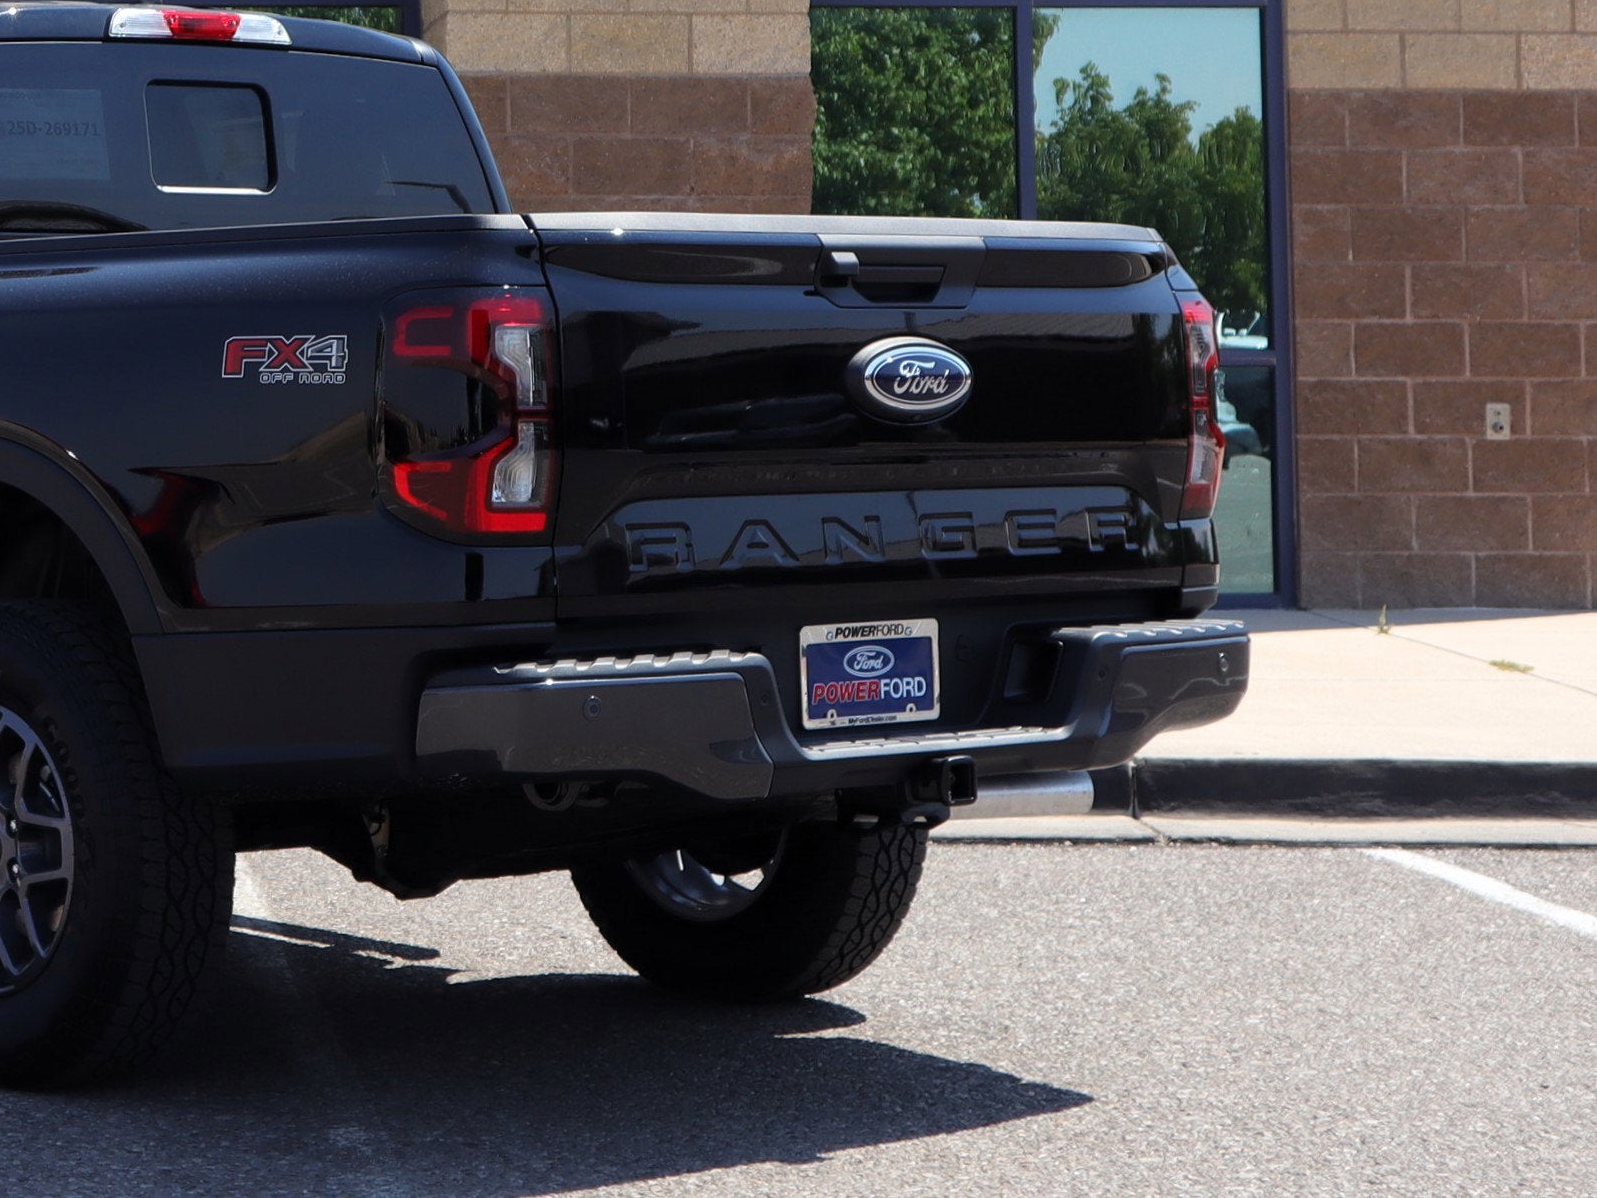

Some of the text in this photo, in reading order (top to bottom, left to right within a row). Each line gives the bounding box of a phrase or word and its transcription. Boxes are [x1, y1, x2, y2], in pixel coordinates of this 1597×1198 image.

[222, 334, 348, 379] FX4
[259, 372, 346, 384] OFF ROAD
[893, 360, 950, 395] Ford
[625, 507, 1141, 573] RANGER
[834, 623, 904, 639] POWERFORD
[853, 651, 884, 671] Ford
[812, 676, 927, 706] POWERFORD
